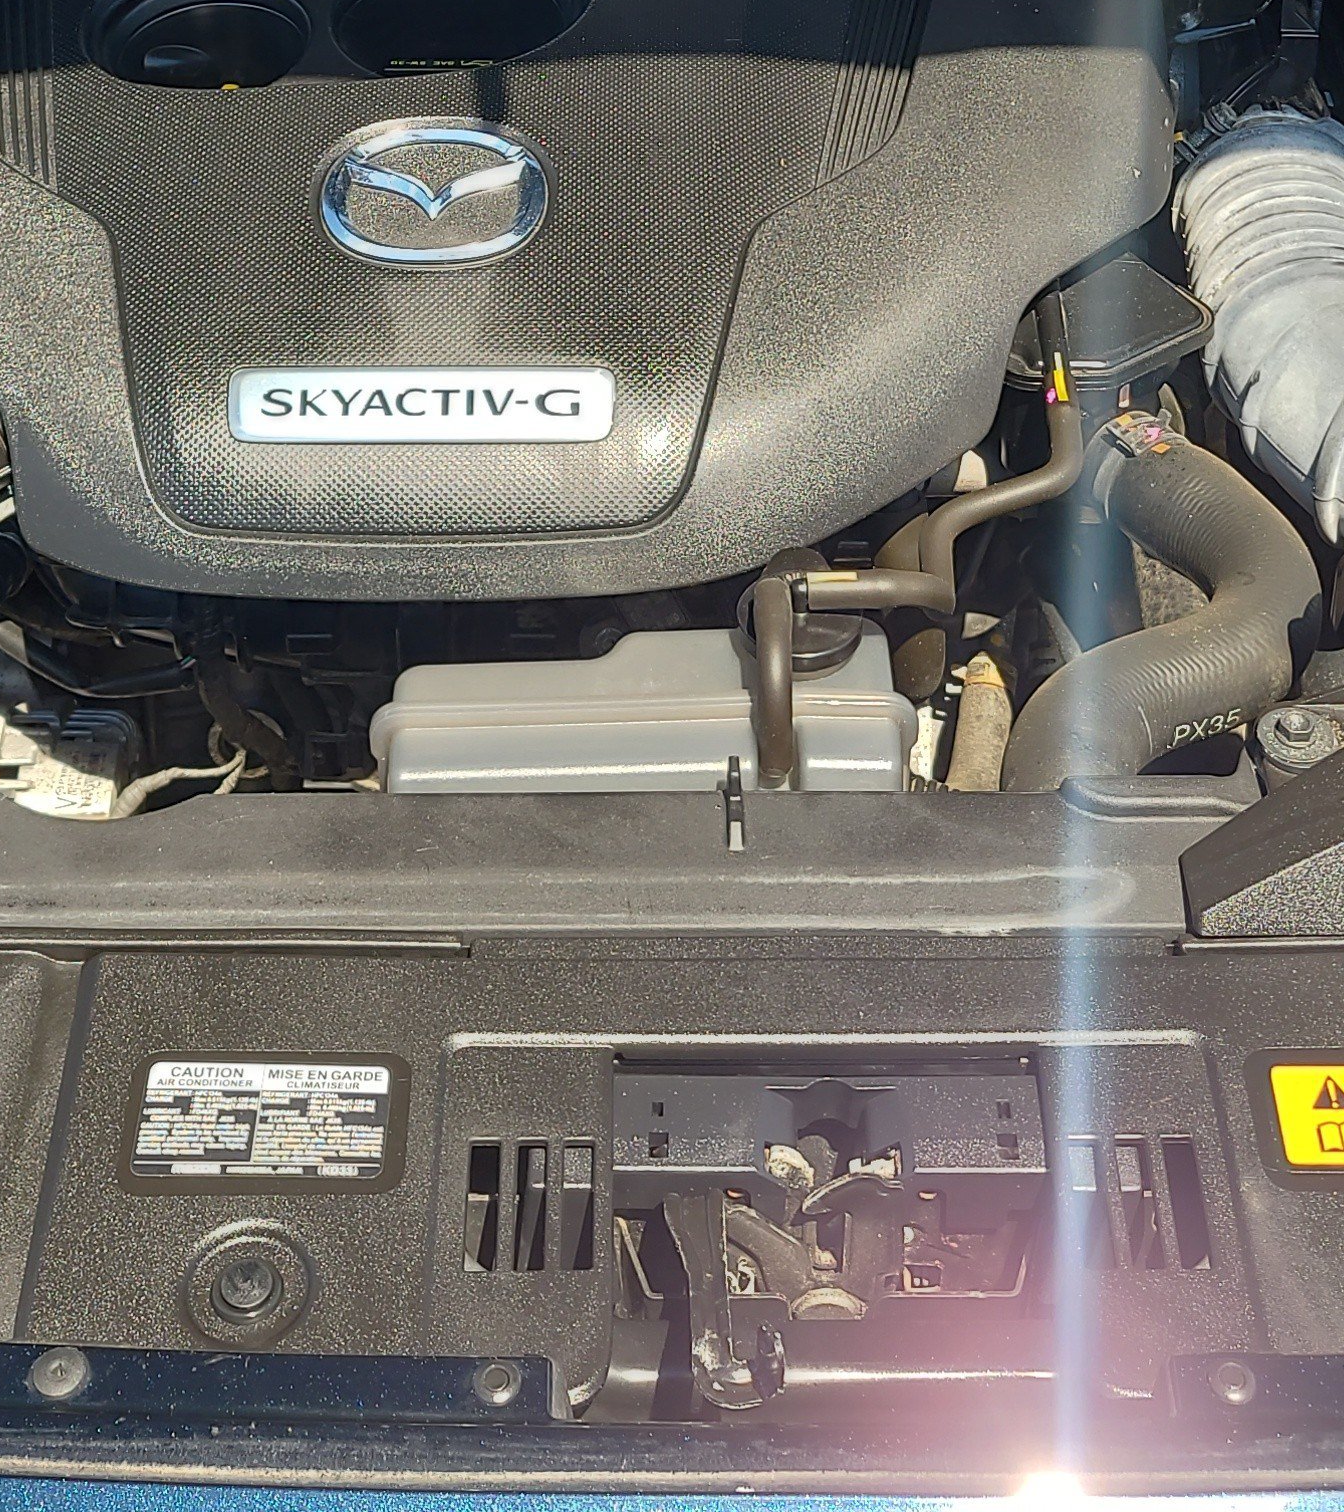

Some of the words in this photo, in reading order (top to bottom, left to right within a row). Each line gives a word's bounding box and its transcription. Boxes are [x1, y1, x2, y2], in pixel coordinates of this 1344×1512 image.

[260, 387, 581, 417] SKYACTIV-G
[170, 1066, 245, 1078] CAUTION
[267, 1068, 304, 1080] MISE
[306, 1069, 329, 1080] EN
[331, 1070, 383, 1082] GARDE
[156, 1078, 176, 1087] AIR
[179, 1078, 254, 1088] CONDITIONER
[286, 1080, 360, 1090] CLIMATISEUR
